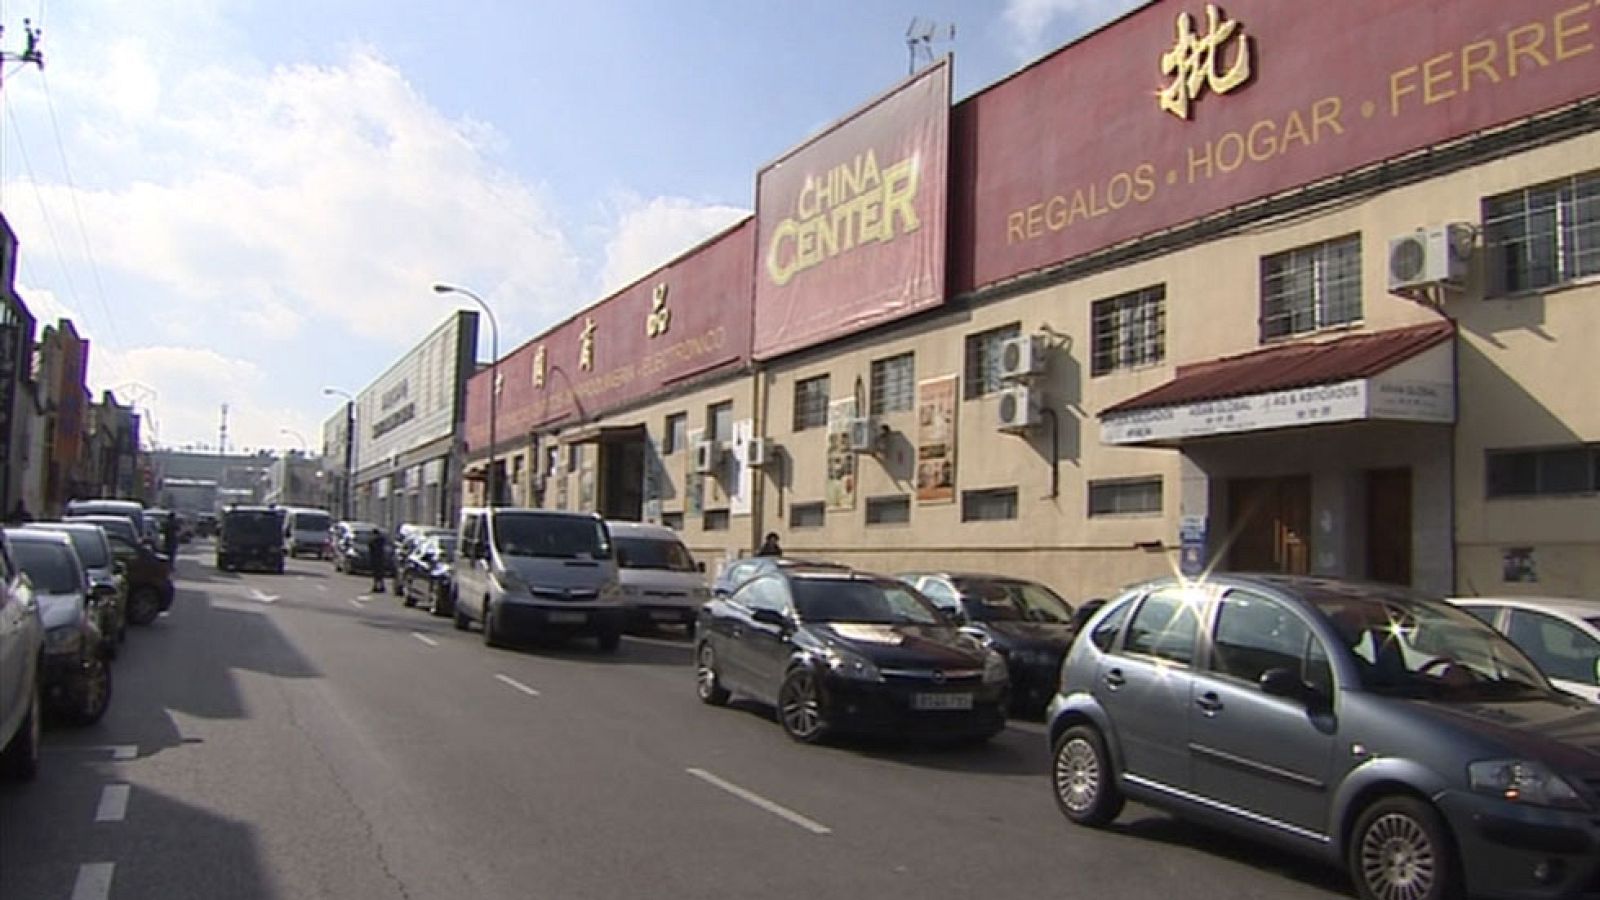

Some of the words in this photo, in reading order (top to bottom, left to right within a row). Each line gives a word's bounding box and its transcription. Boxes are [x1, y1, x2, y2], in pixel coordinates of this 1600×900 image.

[1006, 163, 1156, 245] REGALOS
[1187, 96, 1345, 183] HOGAR
[1389, 0, 1600, 117] FERRE
[1160, 4, 1250, 120] 批
[767, 156, 921, 287] CENTER
[799, 148, 881, 221] CHINA
